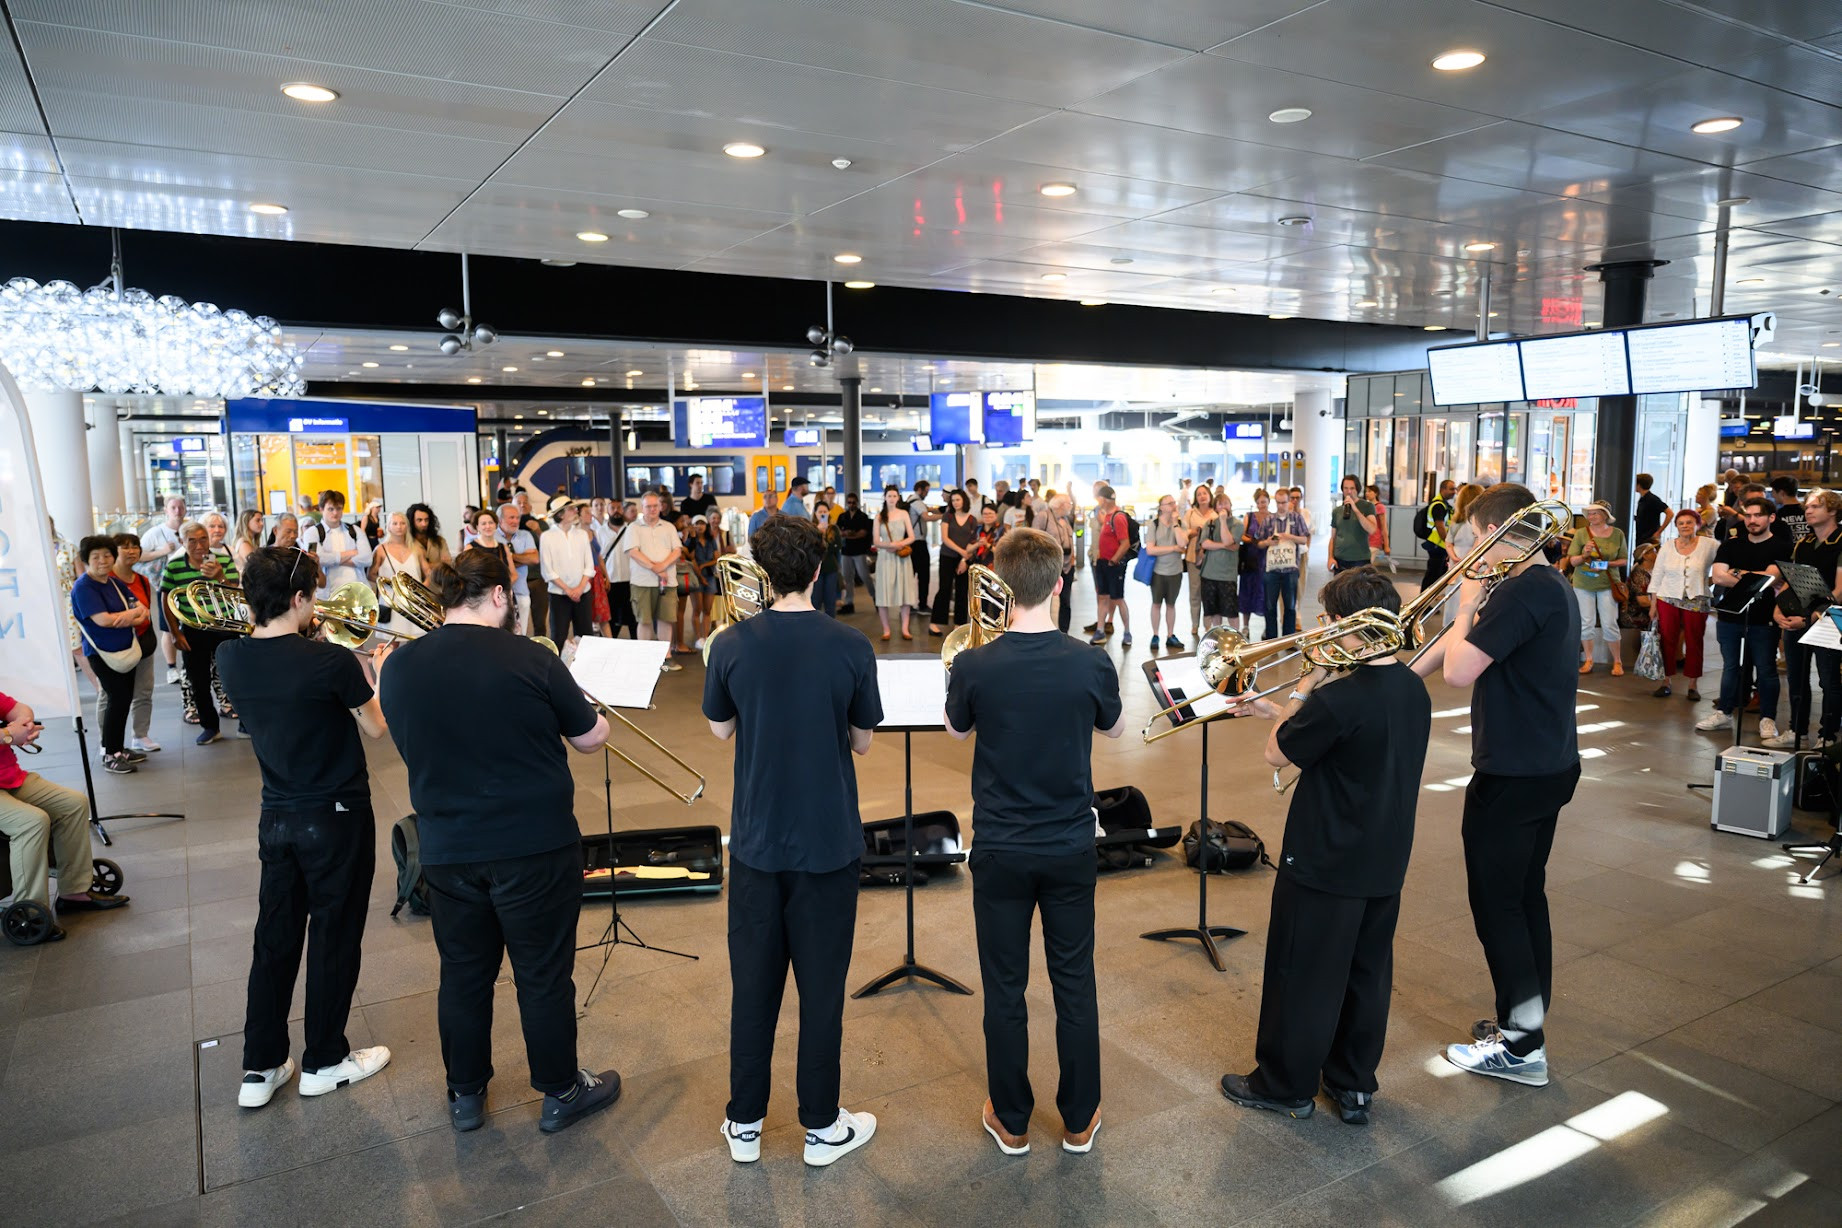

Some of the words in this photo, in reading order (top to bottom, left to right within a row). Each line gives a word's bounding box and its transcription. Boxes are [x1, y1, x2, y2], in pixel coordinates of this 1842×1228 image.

[678, 467, 684, 476] 1
[837, 464, 843, 475] 2
[1781, 514, 1804, 523] NEW
